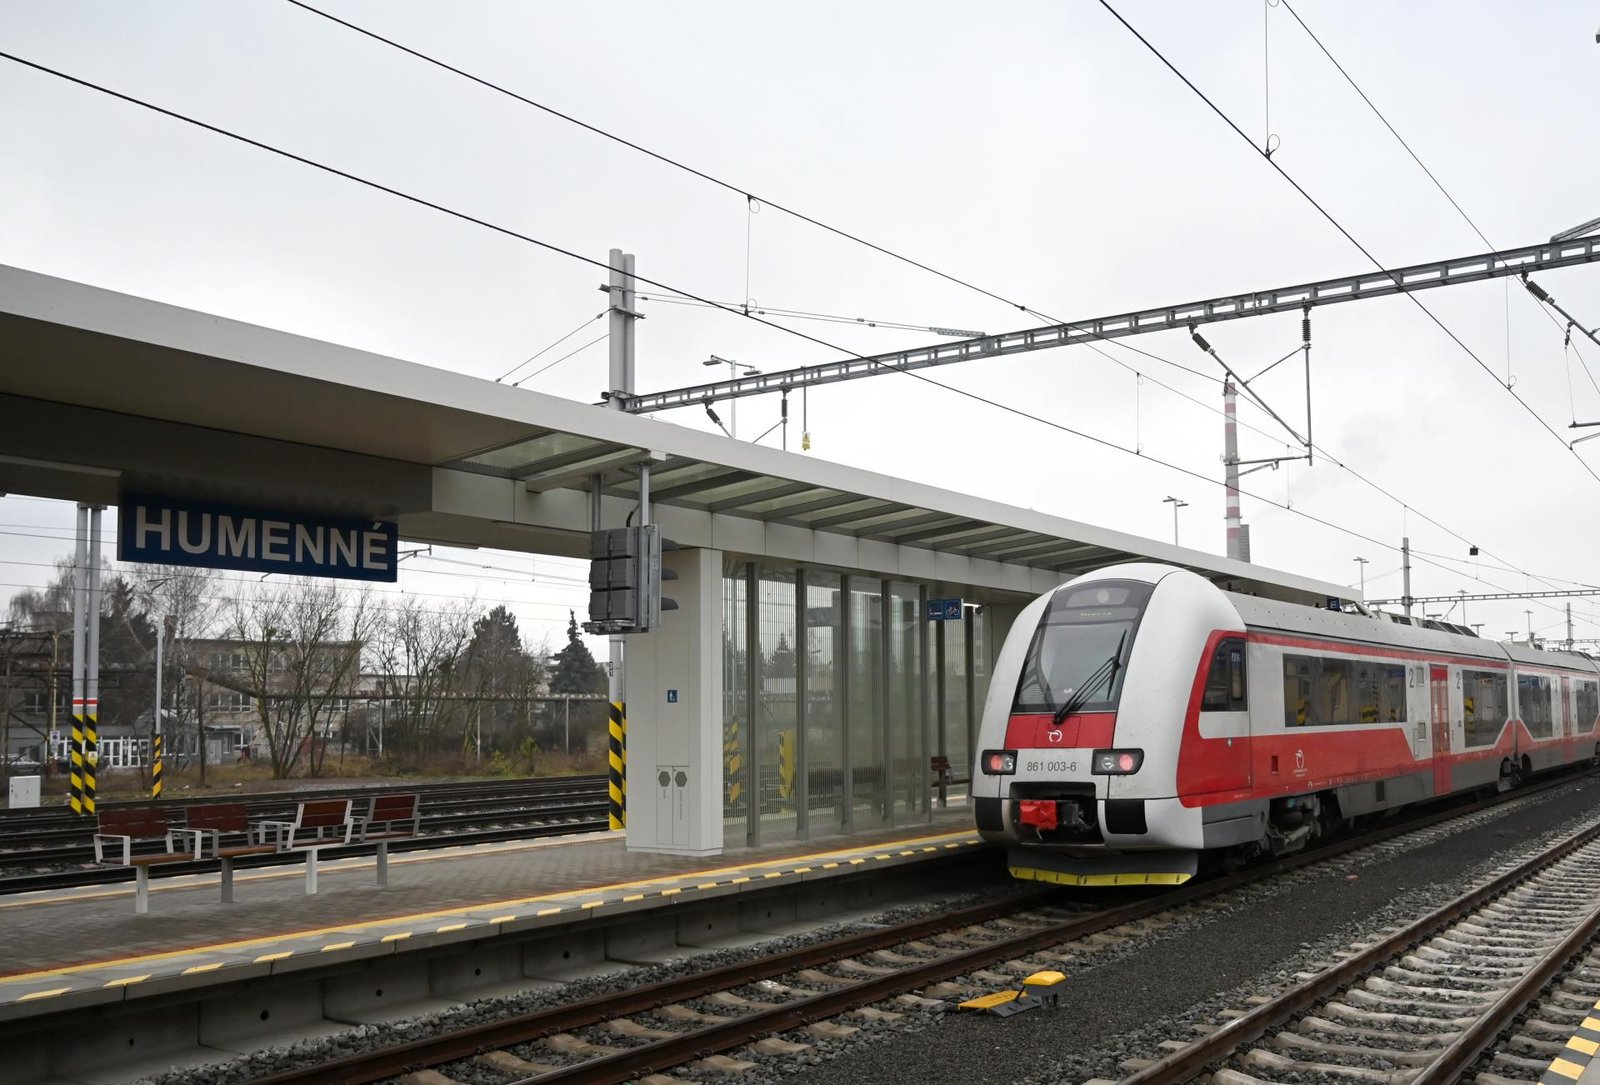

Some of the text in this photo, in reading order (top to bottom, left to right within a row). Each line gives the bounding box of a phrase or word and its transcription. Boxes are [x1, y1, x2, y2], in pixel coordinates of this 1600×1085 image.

[135, 505, 388, 570] HUMENNÉ
[1408, 668, 1414, 688] 2
[1026, 761, 1077, 772] 861 003-6
